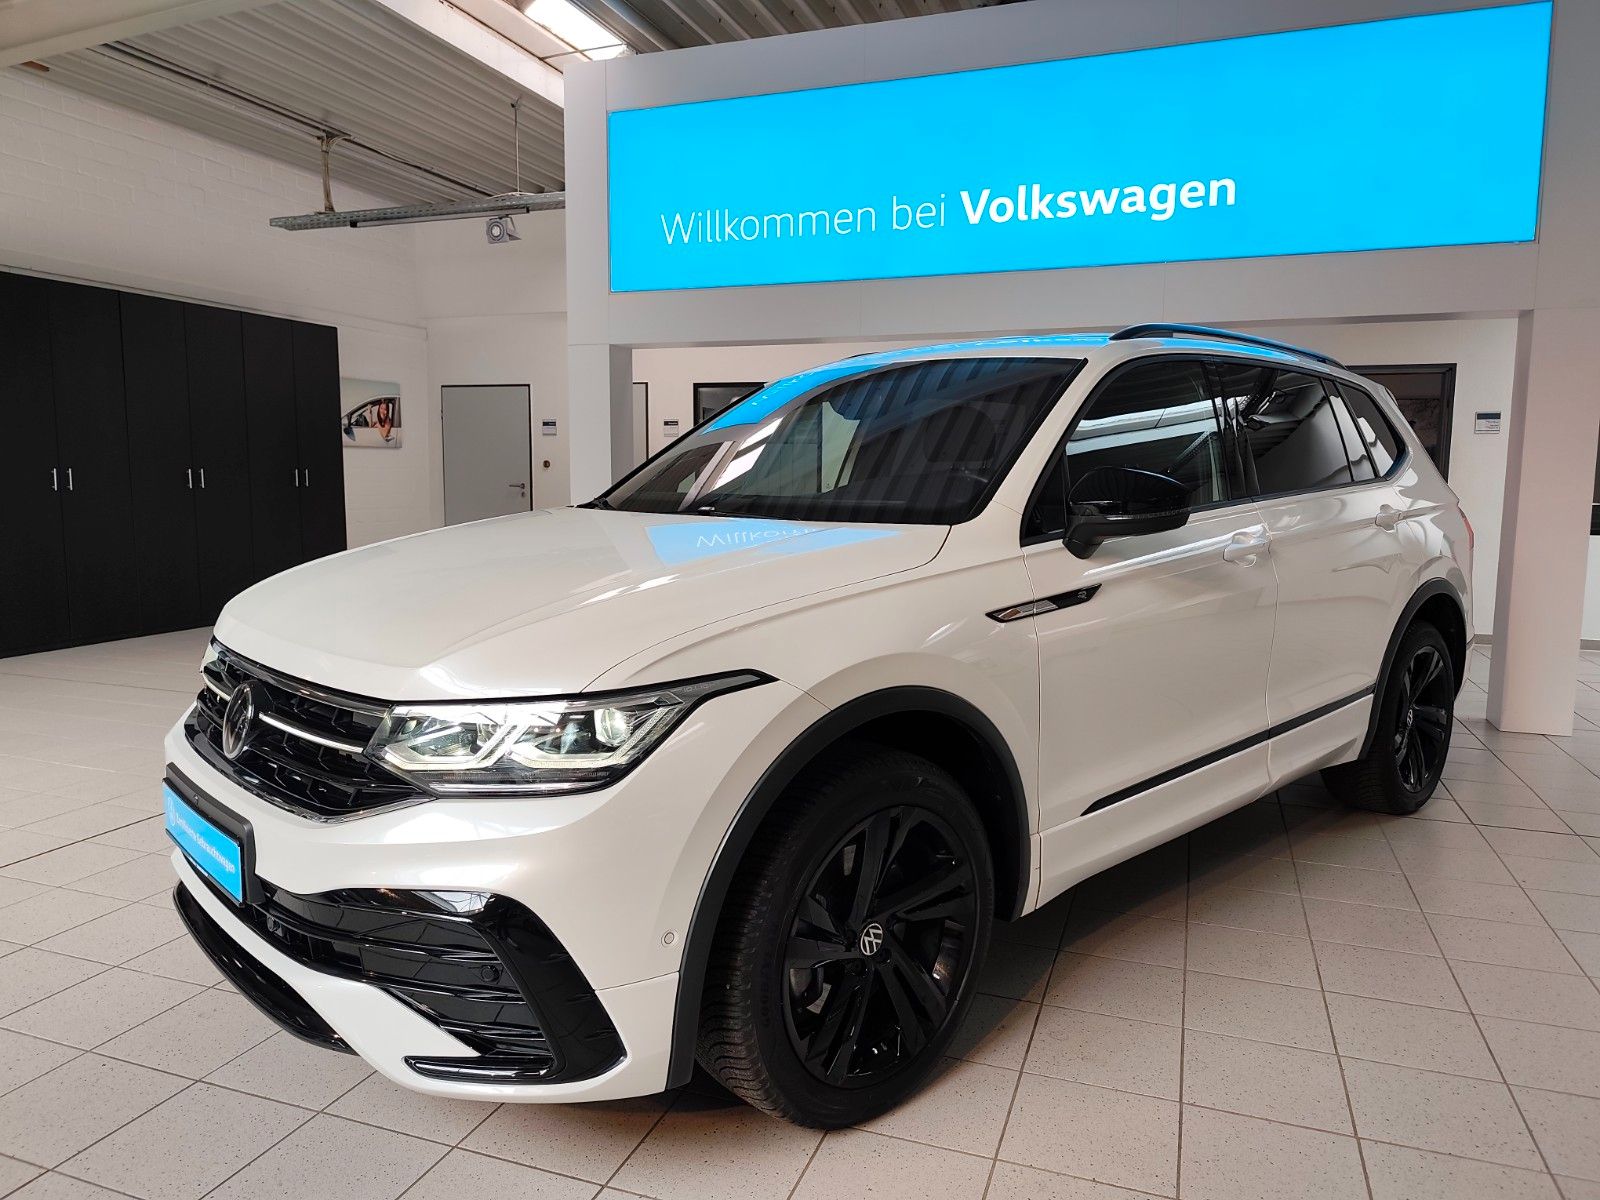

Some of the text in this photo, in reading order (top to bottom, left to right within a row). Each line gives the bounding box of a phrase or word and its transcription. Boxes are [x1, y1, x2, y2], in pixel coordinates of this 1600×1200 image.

[660, 177, 1237, 246] Willkommen bei Volkswagen
